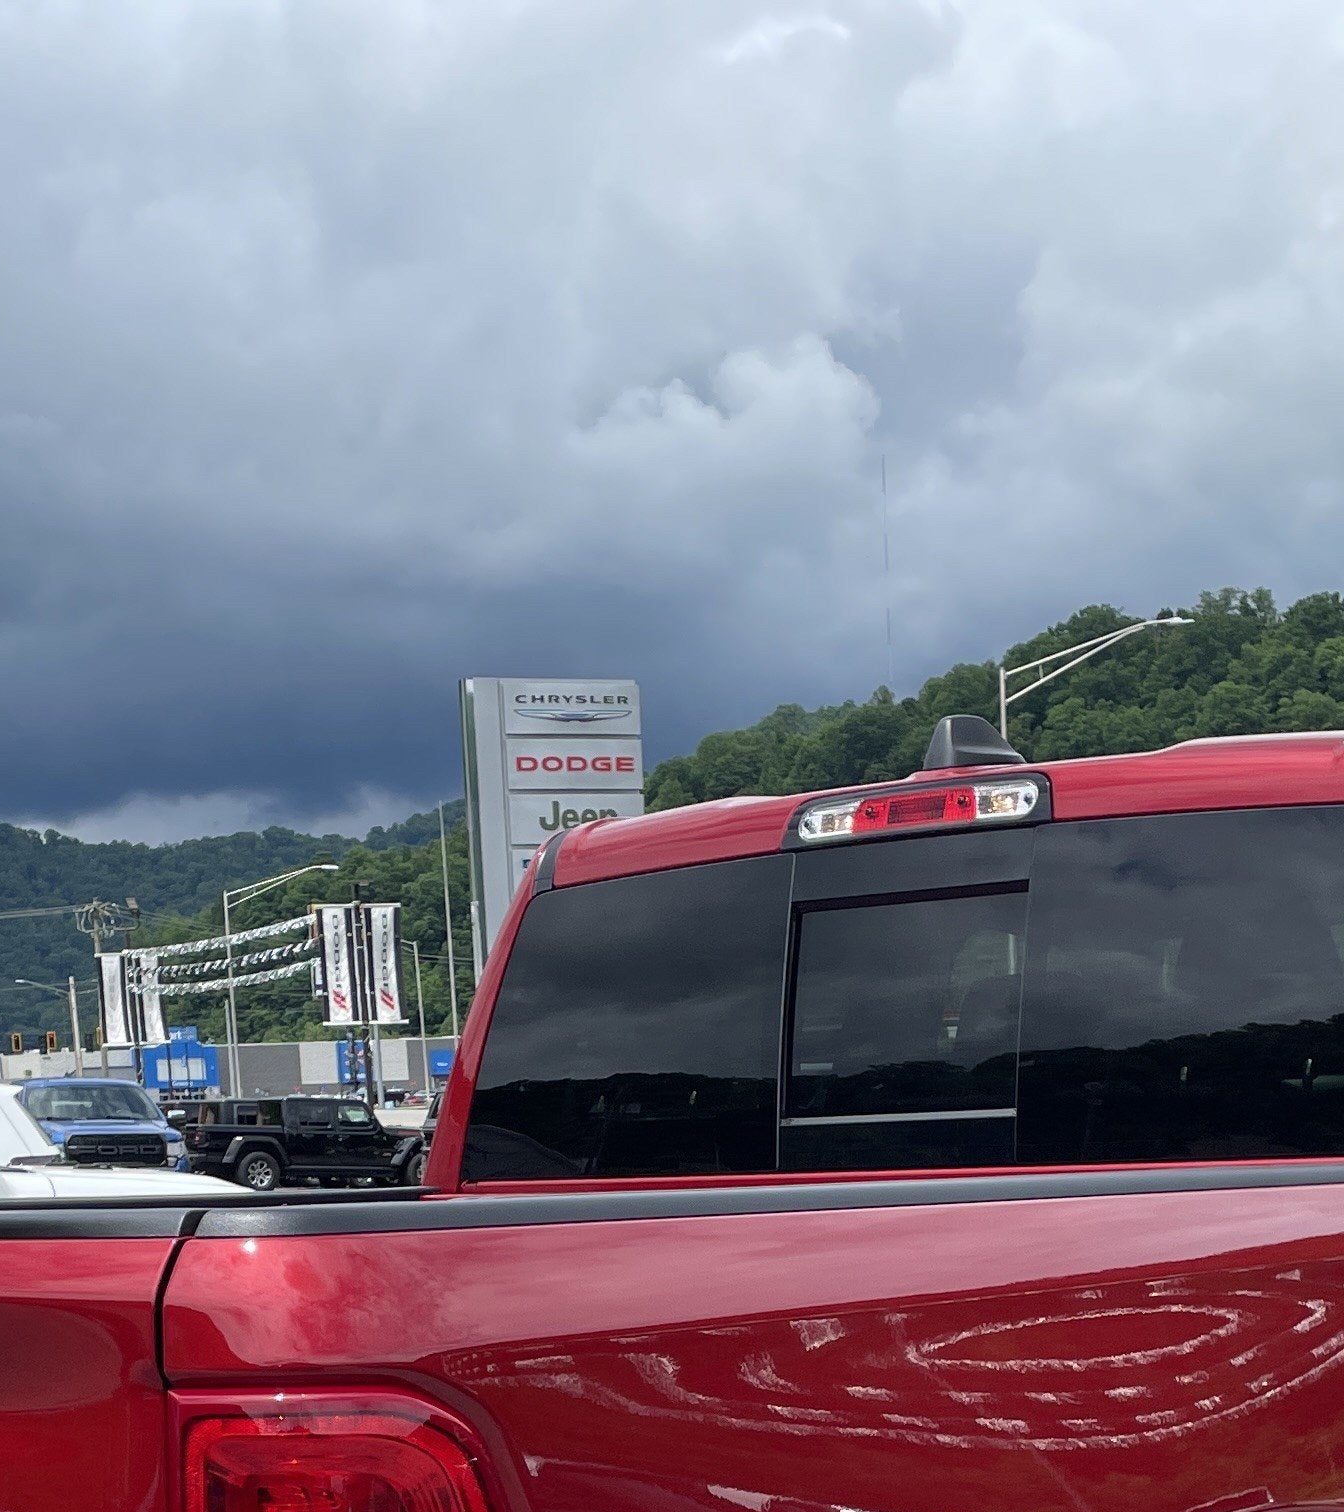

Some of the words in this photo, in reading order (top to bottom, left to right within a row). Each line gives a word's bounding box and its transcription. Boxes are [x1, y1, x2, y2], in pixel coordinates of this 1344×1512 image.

[515, 695, 629, 705] CHRYSLER
[516, 757, 635, 773] DODGE
[67, 1145, 161, 1155] FORD
